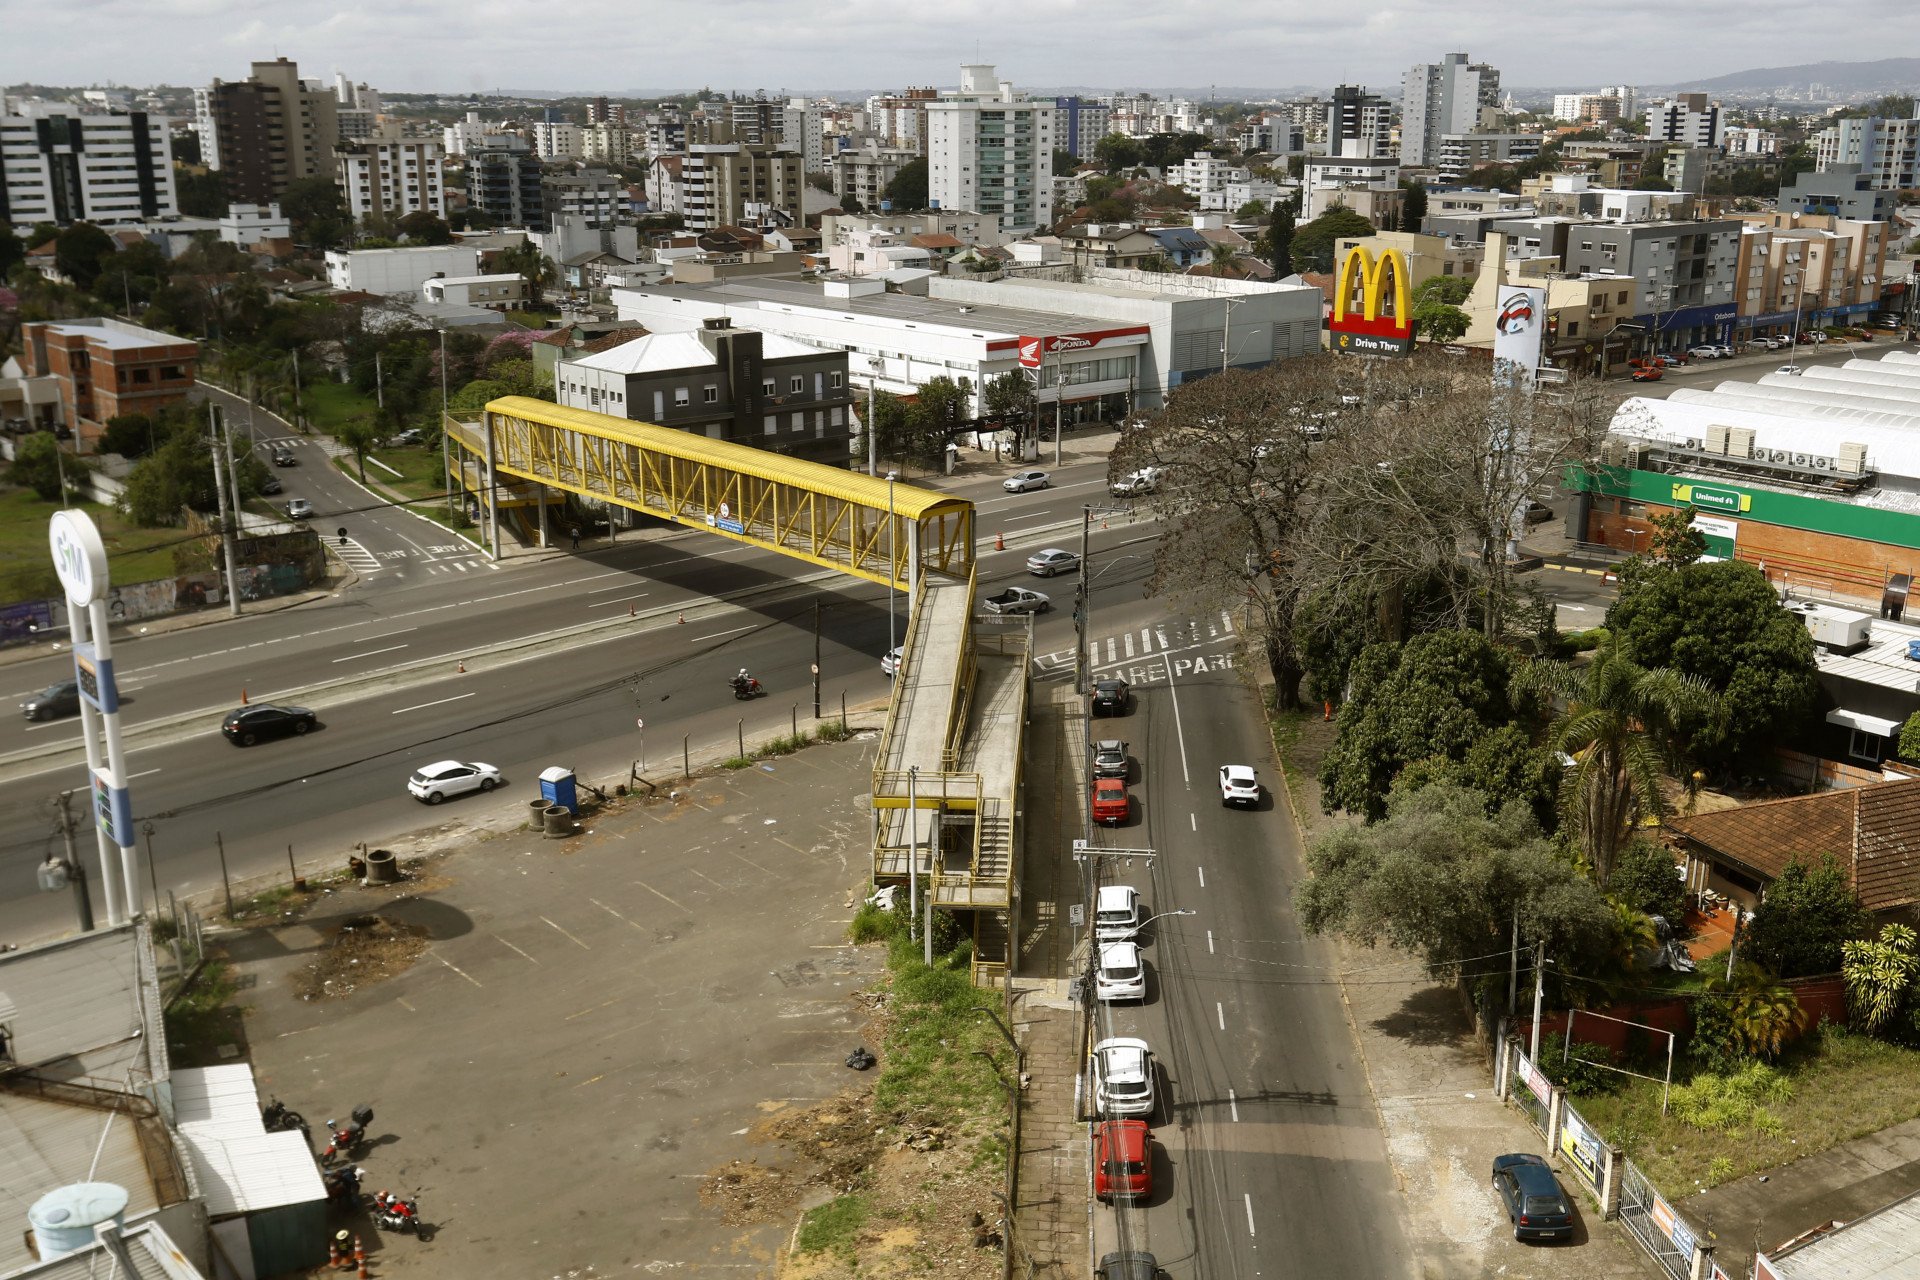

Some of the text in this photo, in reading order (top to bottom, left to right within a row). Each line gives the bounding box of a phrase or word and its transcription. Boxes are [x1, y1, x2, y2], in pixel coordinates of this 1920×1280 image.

[1355, 337, 1399, 352] Drive Thru
[1695, 492, 1724, 503] Unimed
